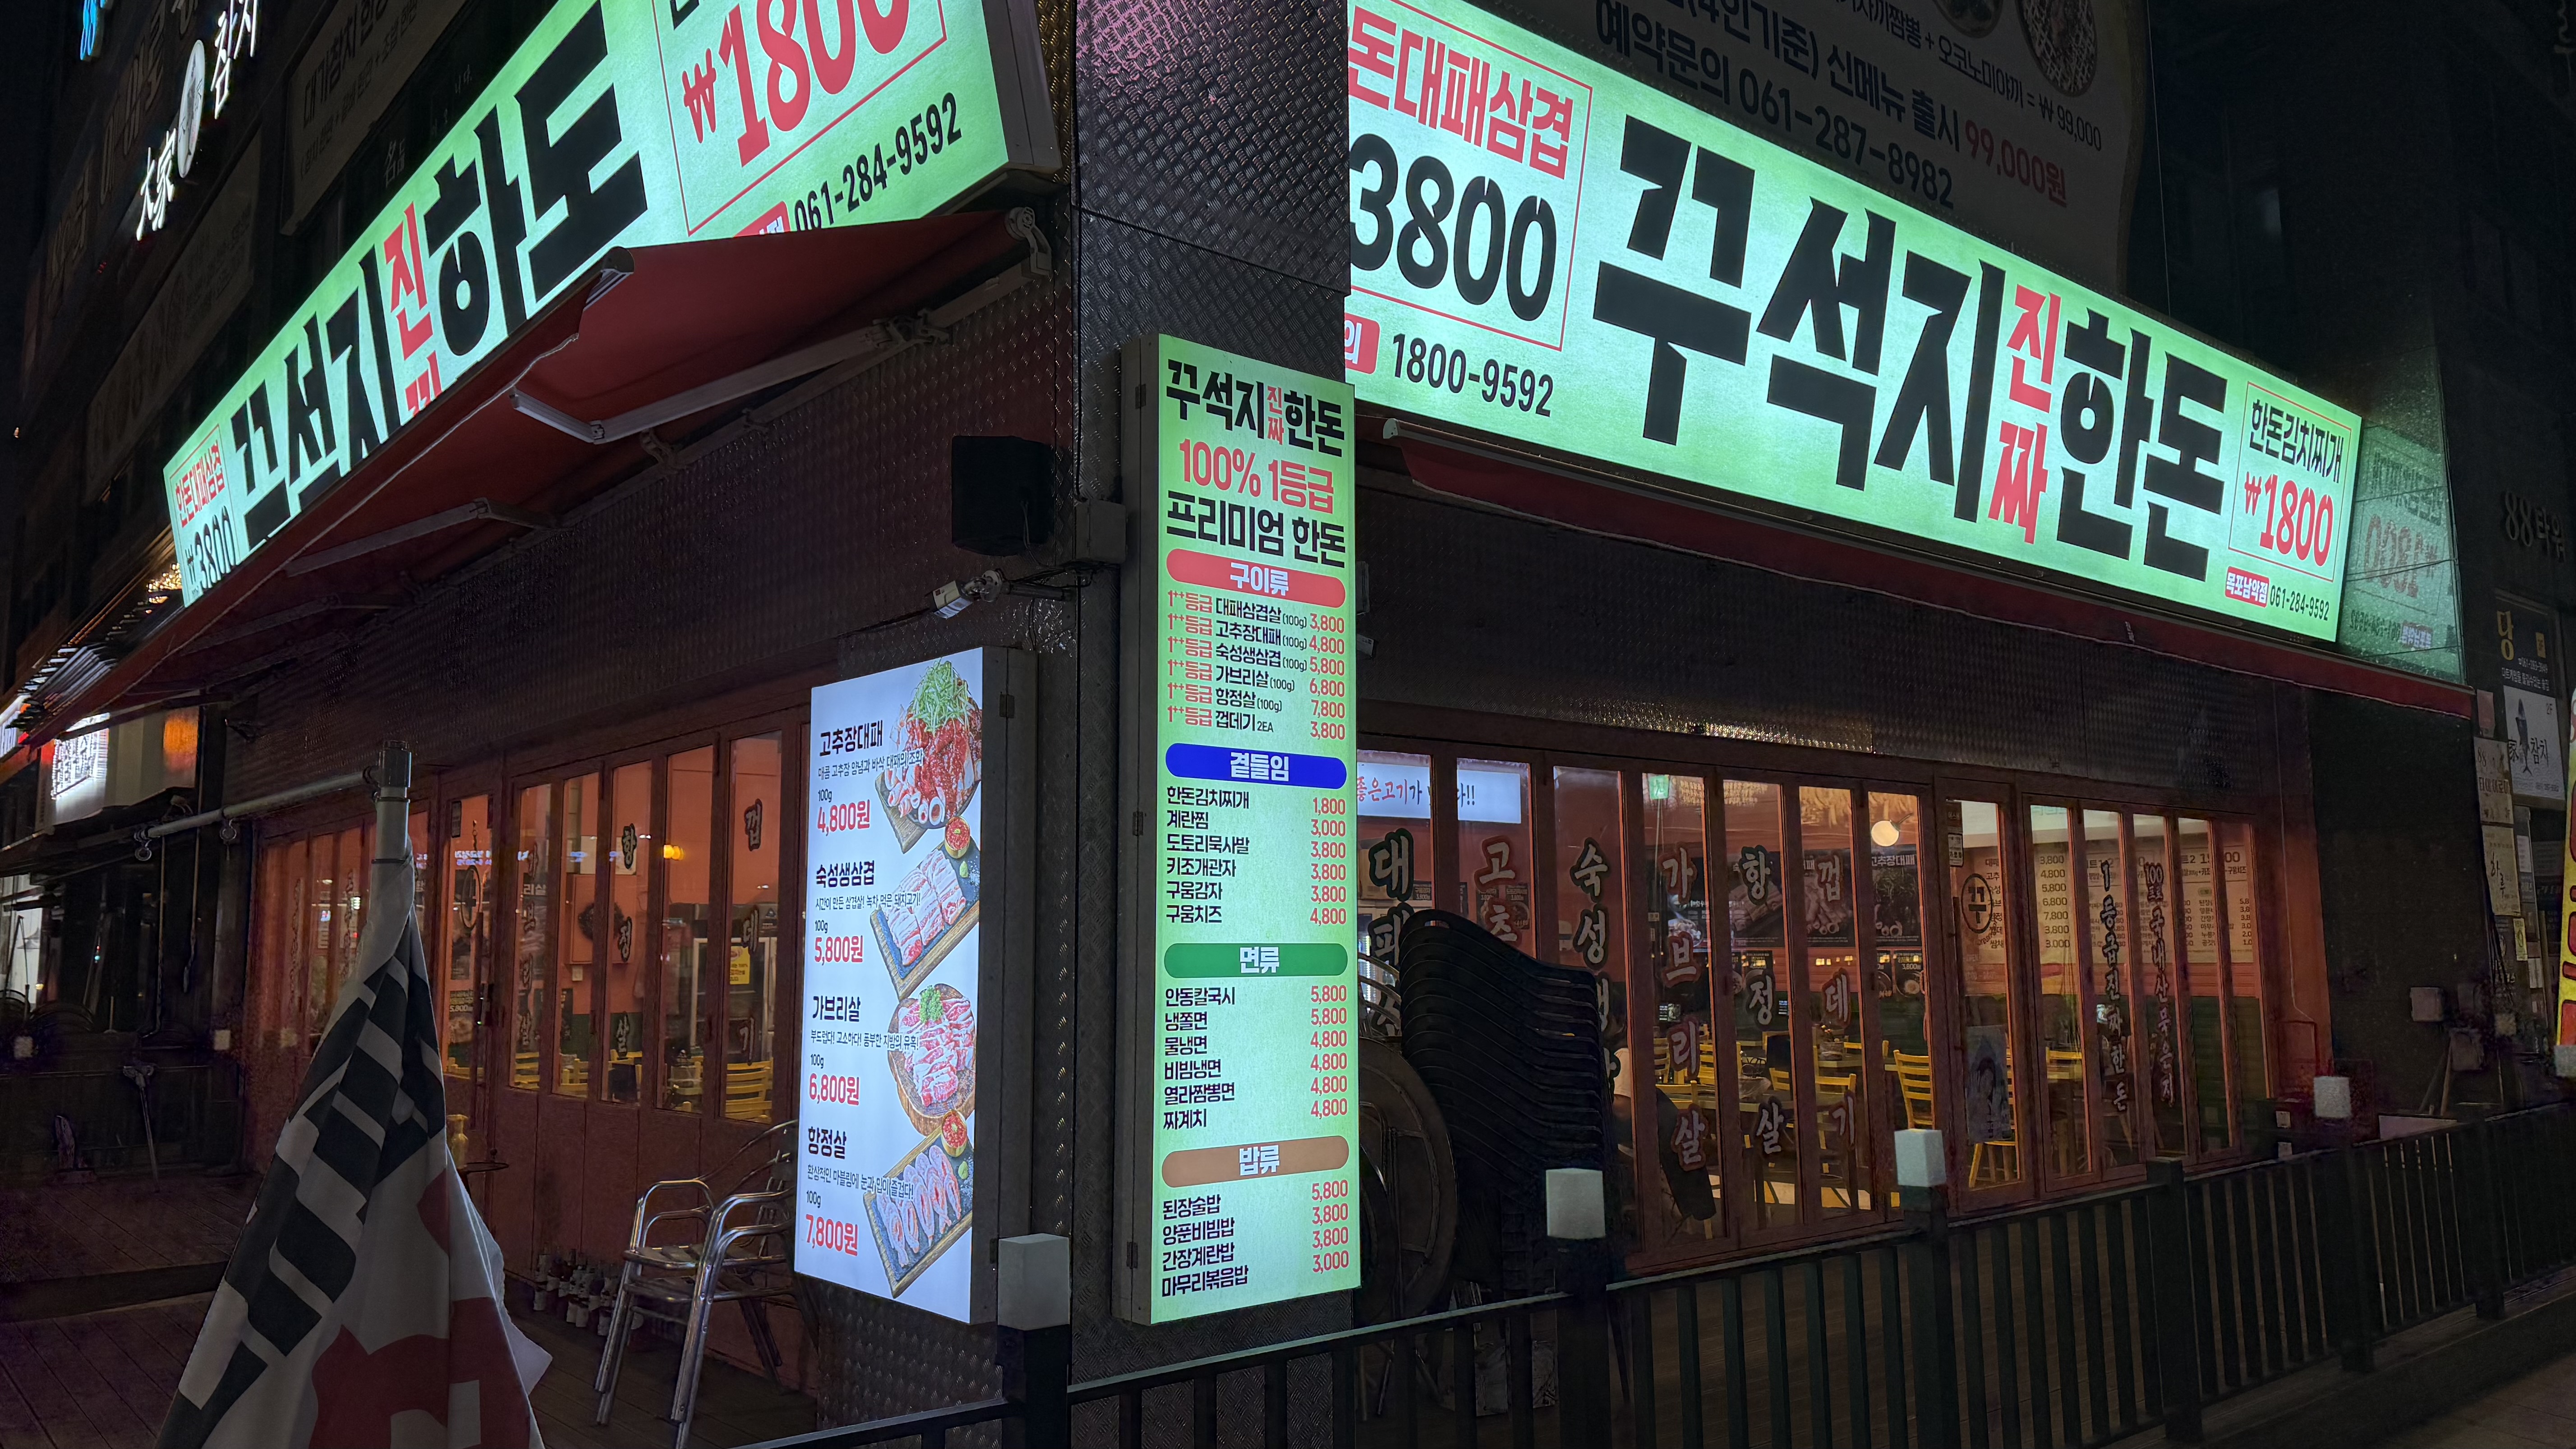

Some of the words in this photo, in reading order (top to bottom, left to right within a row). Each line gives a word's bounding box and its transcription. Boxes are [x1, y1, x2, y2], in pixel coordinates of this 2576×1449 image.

[1596, 0, 1730, 105] 예약문의
[1739, 69, 1954, 209] 061-287-8982
[1827, 45, 1905, 122] 신메뉴
[1912, 89, 1960, 152] 출시
[1939, 35, 2023, 109] 오코노미야끼
[2057, 106, 2101, 151] 99,000
[794, 92, 962, 231] 061-284-9592
[1593, 115, 2006, 523] 꾸석지
[1988, 284, 2061, 544] 진짜
[2057, 308, 2227, 581] 한돈
[1392, 333, 1554, 415] 1800-9592
[1166, 359, 1264, 439] 꾸석지
[1267, 386, 1284, 445] 진짜
[1283, 391, 1345, 457] 한돈
[2249, 399, 2342, 483] 한돈김치찌개
[1179, 438, 1261, 497] 100%
[1268, 460, 1334, 514] 1등급
[1167, 490, 1283, 557] 프리미엄
[1292, 517, 1345, 568] 한돈
[1230, 562, 1289, 596] 구이류
[2226, 570, 2268, 606] 목포남악점
[2270, 584, 2329, 621] 061-284-9592
[1216, 598, 1281, 624] 대패삼겹살
[1283, 613, 1307, 628] (100g)
[1310, 613, 1344, 633] 3,800
[1216, 620, 1281, 646] 고추장대패
[1283, 635, 1307, 649] (100g)
[1309, 635, 1344, 655] 4,800
[1216, 643, 1281, 667] 숙성생삼겹
[1283, 658, 1307, 672] (100g)
[1309, 657, 1344, 676] 5,800
[1216, 665, 1269, 688] 가브리살
[1270, 677, 1295, 693] (100g)
[1309, 678, 1345, 698] 6,800
[1216, 688, 1256, 708] 항정살
[1257, 698, 1282, 713] (100g)
[1311, 699, 1345, 719] 7,800
[819, 720, 883, 756] 고추장대패
[1216, 711, 1256, 732] 껍데기
[1257, 721, 1274, 732] 2EA
[1310, 721, 1345, 740] 3,800
[832, 764, 850, 777] 고추장
[851, 760, 870, 775] 양념과
[872, 758, 884, 771] 바삭
[887, 753, 907, 768] 대패의
[909, 750, 923, 765] 조화
[1230, 751, 1289, 782] 곁들임
[2530, 737, 2548, 767] 참치
[818, 790, 832, 803] 100g
[1167, 787, 1249, 809] 한돈김치찌개
[1313, 797, 1345, 815] 1,800
[817, 799, 870, 837] 4,800원
[1167, 810, 1209, 830] 계란찜
[1311, 819, 1346, 837] 3,000
[1167, 833, 1250, 855] 도토리묵사발
[1311, 841, 1346, 859] 3,800
[816, 860, 874, 888] 숙성생삼겹
[1167, 857, 1236, 877] 키조개관자
[1311, 863, 1346, 881] 3,800
[815, 897, 831, 911] 시간이
[833, 897, 844, 910] 만든
[846, 896, 865, 909] 삼겹살!
[866, 896, 879, 909] 녹차
[880, 894, 892, 907] 먹은
[894, 892, 920, 907] 돼지고기!
[1166, 881, 1223, 900] 구움감자
[1311, 885, 1346, 904] 3,800
[815, 920, 828, 933] 100g
[1166, 905, 1222, 923] 구움치즈
[1310, 908, 1346, 926] 4,800
[814, 935, 863, 966] 5,800원
[1240, 946, 1279, 974] 면류
[812, 996, 860, 1022] 가브리살
[1165, 987, 1235, 1007] 안동칼국시
[1311, 985, 1347, 1004] 5,800
[1662, 847, 1706, 1166] 가브리살
[1743, 848, 1784, 1155] 항정살
[1818, 854, 1854, 1145] 껍데기
[1165, 1011, 1207, 1031] 냉쫄면
[1311, 1007, 1347, 1026] 5,800
[811, 1030, 834, 1044] 부드럽다!
[837, 1032, 861, 1046] 고소하다!
[864, 1033, 881, 1048] 풍부한
[904, 1035, 918, 1050] 유혹!
[1164, 1035, 1207, 1056] 물냉면
[1310, 1030, 1347, 1049] 4,800
[810, 1053, 824, 1069] 100g
[1164, 1059, 1221, 1080] 비빔냉면
[1310, 1053, 1347, 1073] 4,800
[809, 1073, 860, 1106] 6,800원
[1164, 1082, 1235, 1105] 열라짬뽕면
[1310, 1075, 1348, 1096] 4,800
[1163, 1109, 1207, 1130] 짜계치
[1311, 1098, 1348, 1119] 4,800
[808, 1126, 847, 1159] 항정살
[1239, 1145, 1279, 1176] 밥류
[807, 1164, 832, 1184] 환상적인
[833, 1170, 859, 1190] 마블링에
[860, 1174, 875, 1193] 눈과
[890, 1178, 914, 1200] 즐겁다!
[806, 1190, 821, 1208] 100g
[1163, 1194, 1221, 1220] 된장술밥
[1311, 1179, 1348, 1202] 5,800
[805, 1214, 858, 1256] 7,800원
[1163, 1217, 1235, 1245] 양푼비빔밥
[1312, 1203, 1348, 1226] 3,800
[1162, 1242, 1235, 1271] 간장계란밥
[1312, 1227, 1349, 1250] 3,800
[1162, 1265, 1248, 1297] 마무리볶음밥
[1312, 1250, 1349, 1274] 3,000
